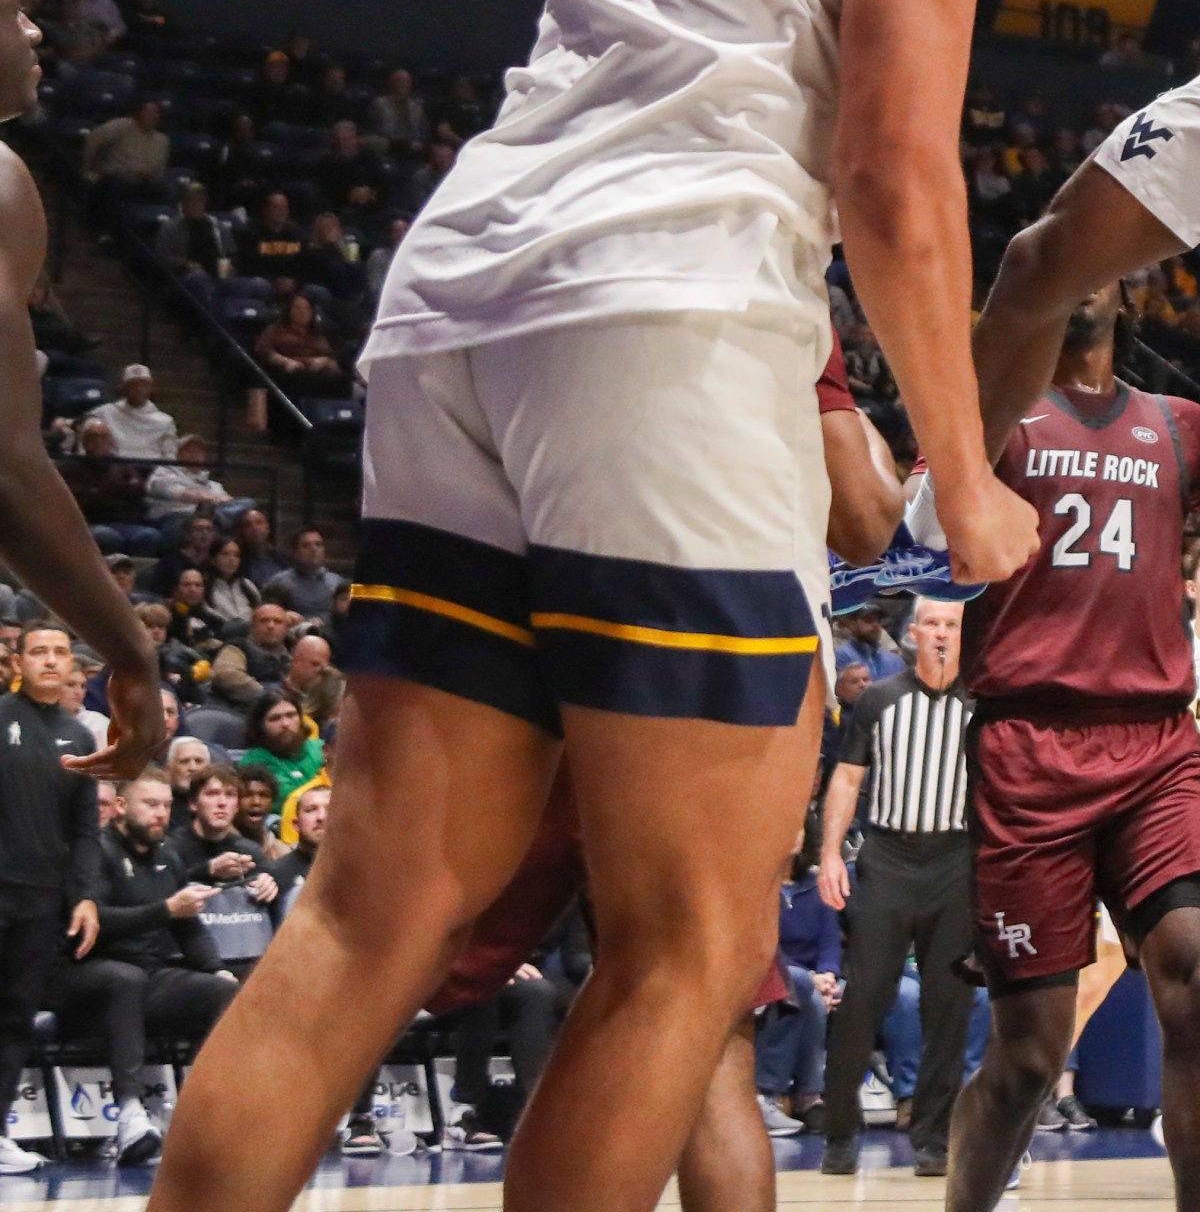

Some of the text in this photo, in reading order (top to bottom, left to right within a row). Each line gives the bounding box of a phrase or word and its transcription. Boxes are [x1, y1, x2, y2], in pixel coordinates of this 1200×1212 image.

[1025, 448, 1160, 494] LITTLE ROCK
[1052, 497, 1136, 571] 24
[994, 911, 1038, 959] LR
